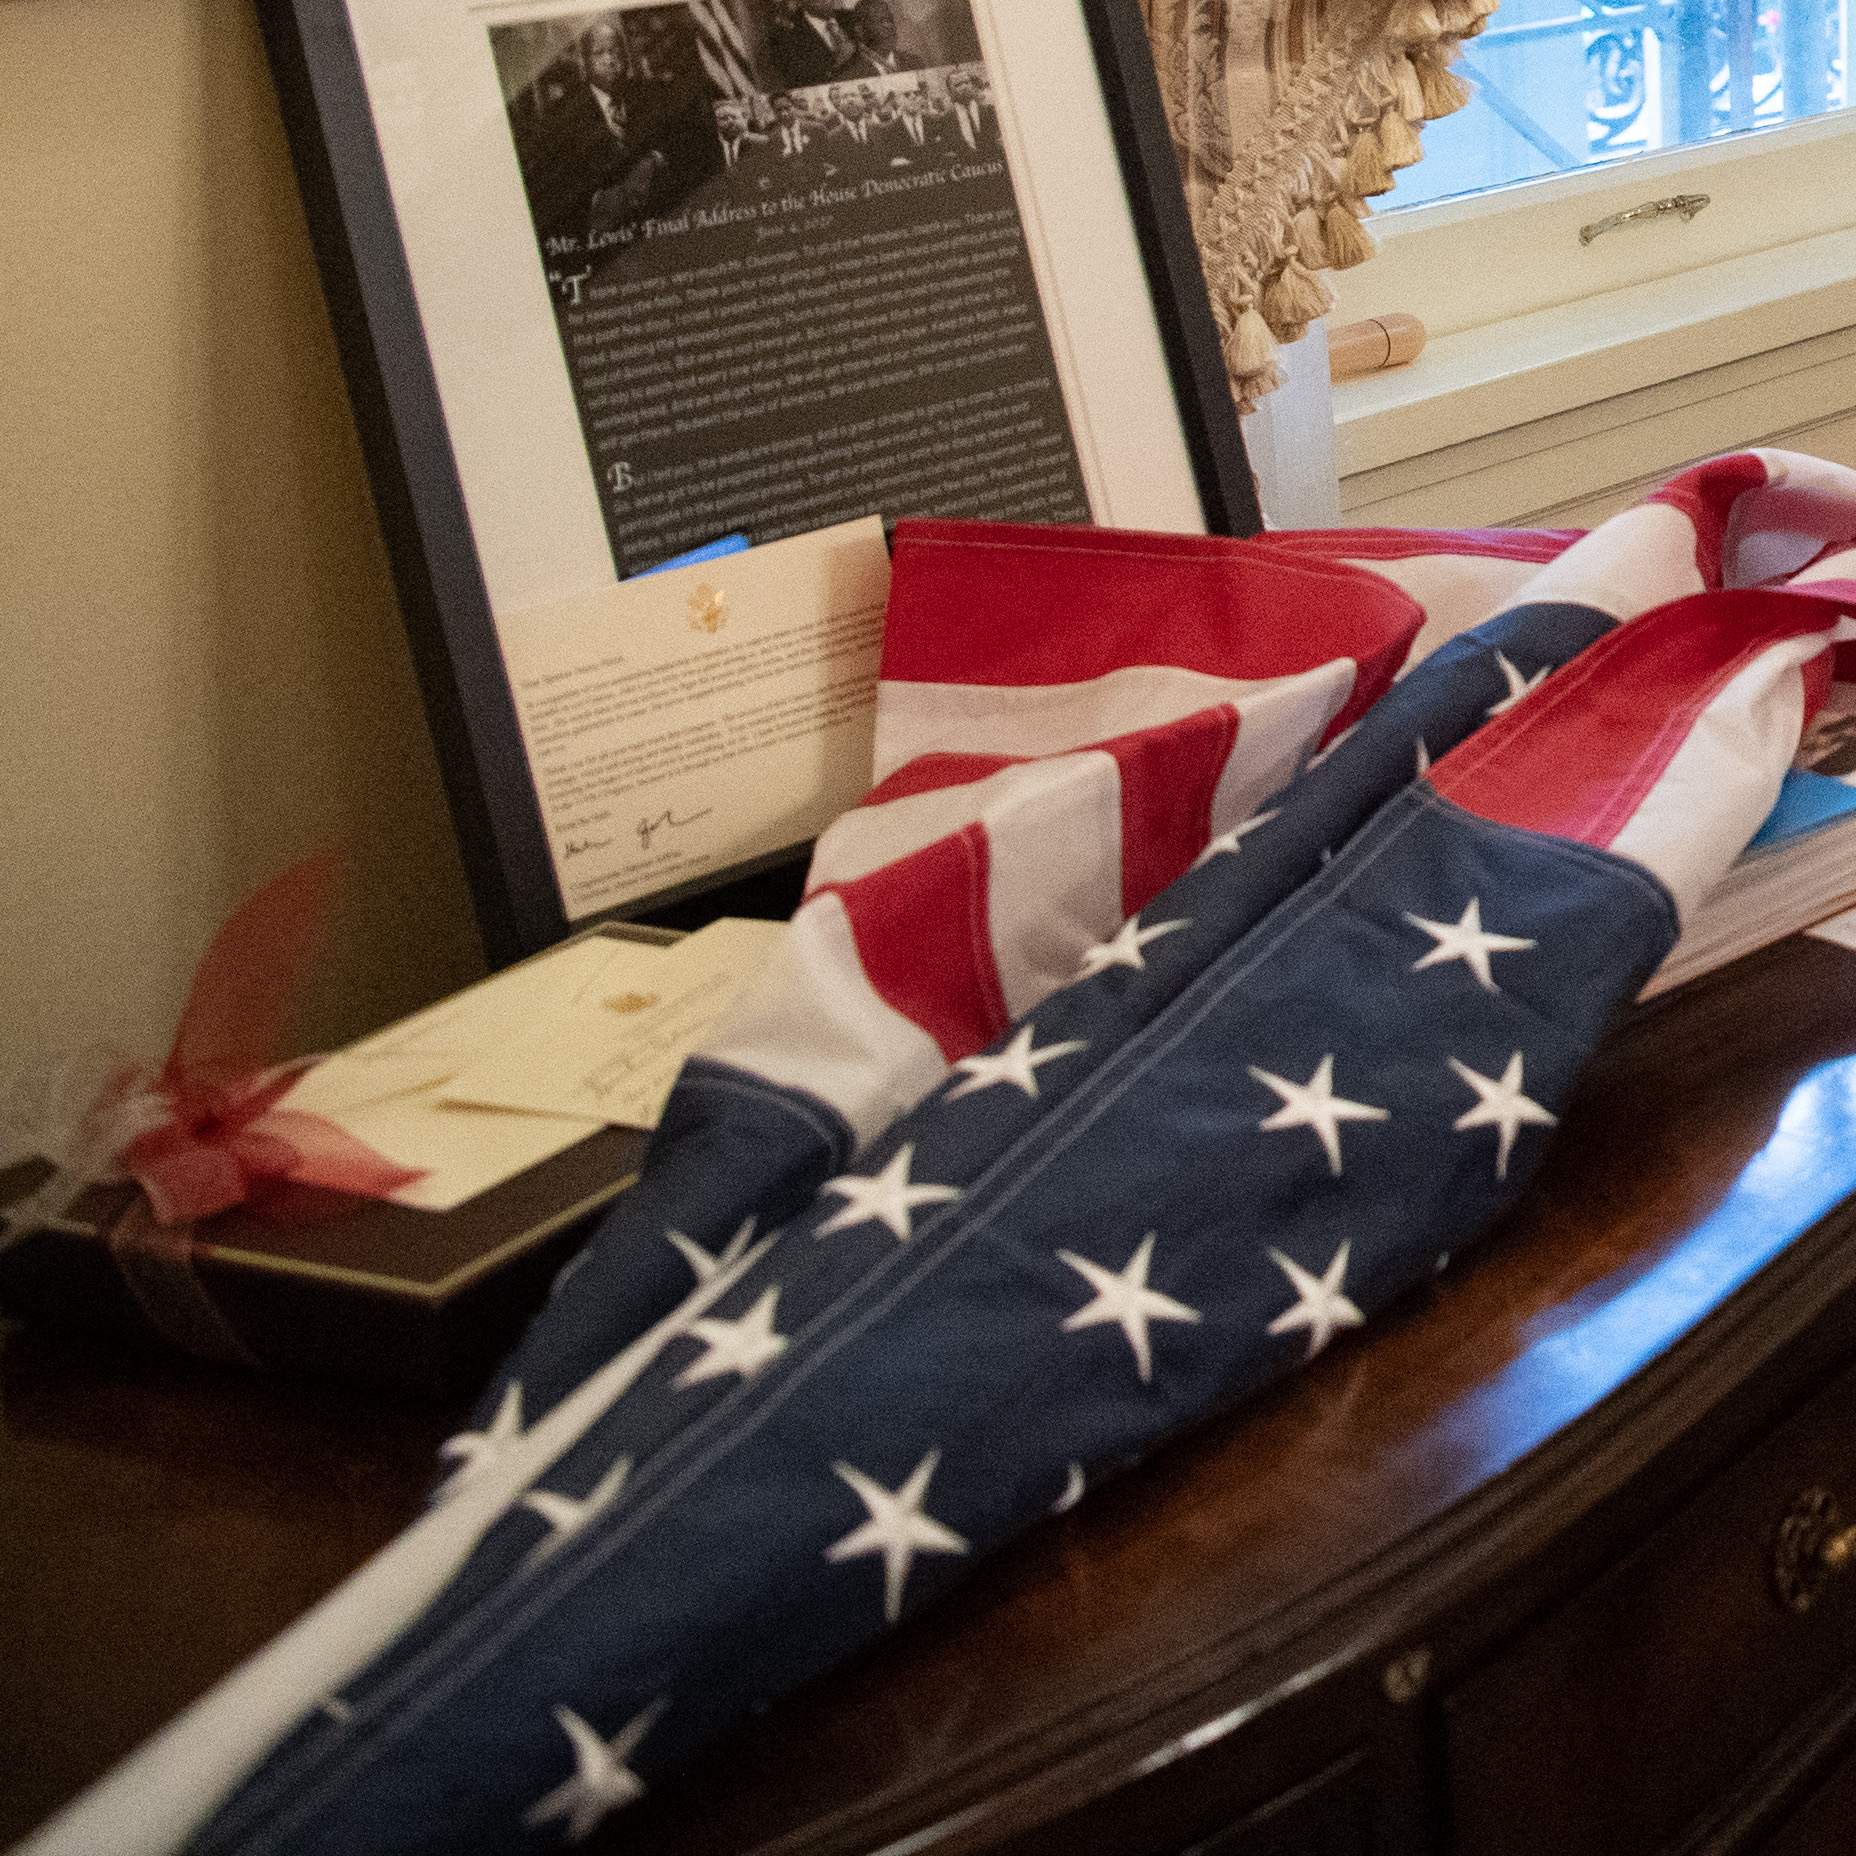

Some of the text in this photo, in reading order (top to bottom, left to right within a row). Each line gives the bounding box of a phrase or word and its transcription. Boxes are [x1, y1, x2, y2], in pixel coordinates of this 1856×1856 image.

[545, 234, 582, 256] Mr.
[644, 213, 691, 239] Final
[693, 200, 758, 230] Address
[760, 199, 780, 216] to
[782, 192, 807, 212] the
[809, 181, 858, 206] House
[861, 169, 947, 197] Democratic
[951, 157, 1003, 181] Caucus
